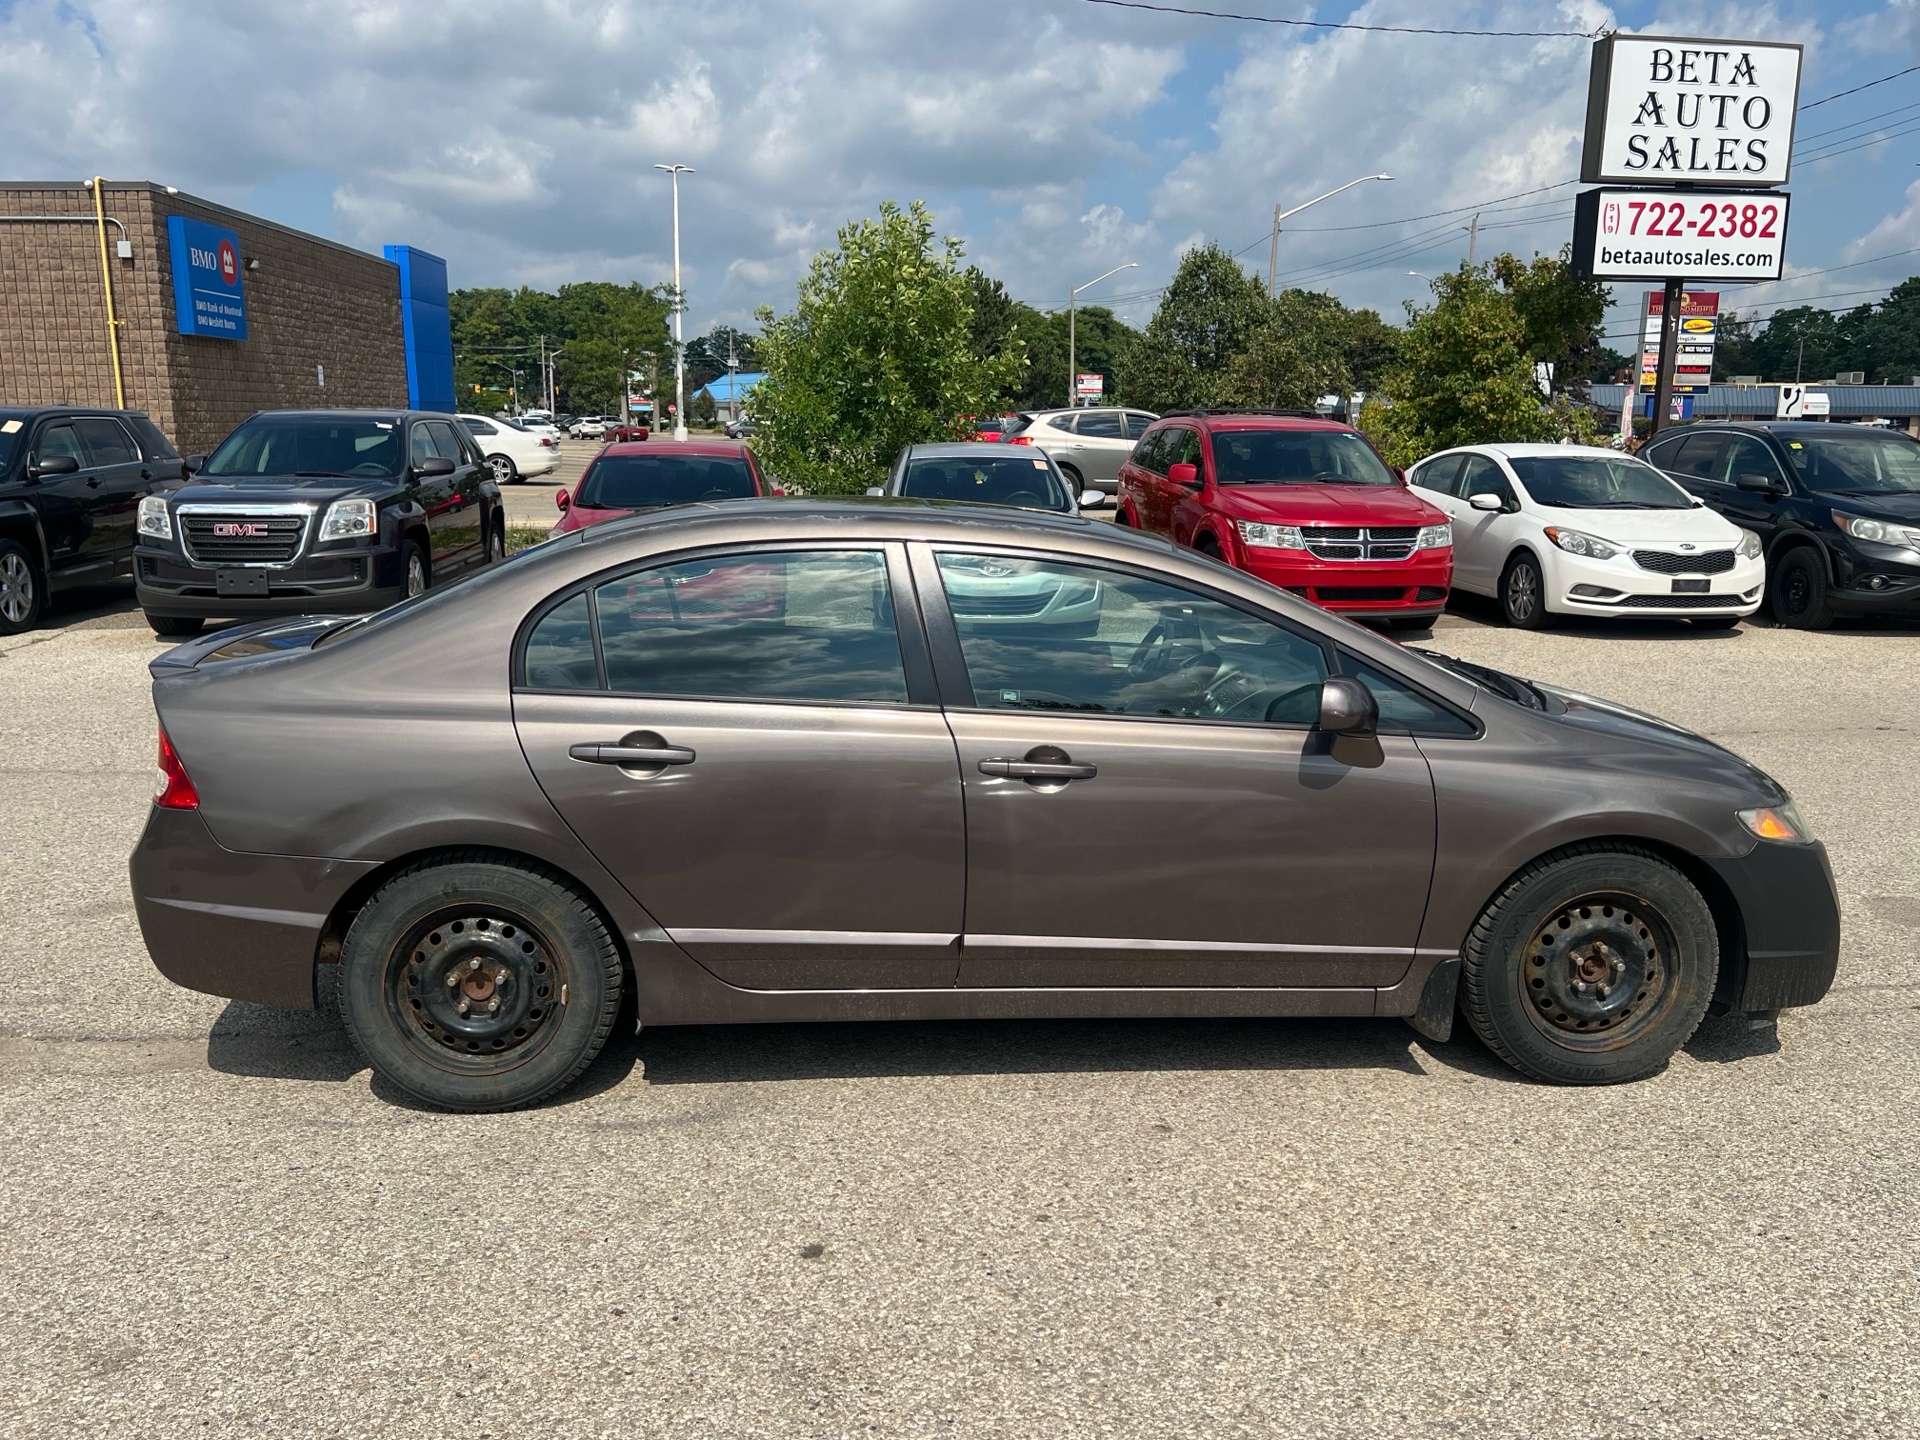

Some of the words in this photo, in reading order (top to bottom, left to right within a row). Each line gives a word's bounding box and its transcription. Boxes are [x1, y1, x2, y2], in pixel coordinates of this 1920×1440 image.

[1650, 48, 1759, 87] BETA
[1631, 91, 1772, 131] AUTO
[1623, 134, 1769, 174] SALES
[1628, 202, 1778, 239] 722-2382
[190, 247, 217, 271] BMO
[1601, 247, 1773, 267] betaautosales.com
[207, 302, 218, 313] Bank
[218, 304, 224, 314] of
[213, 523, 268, 537] GMC
